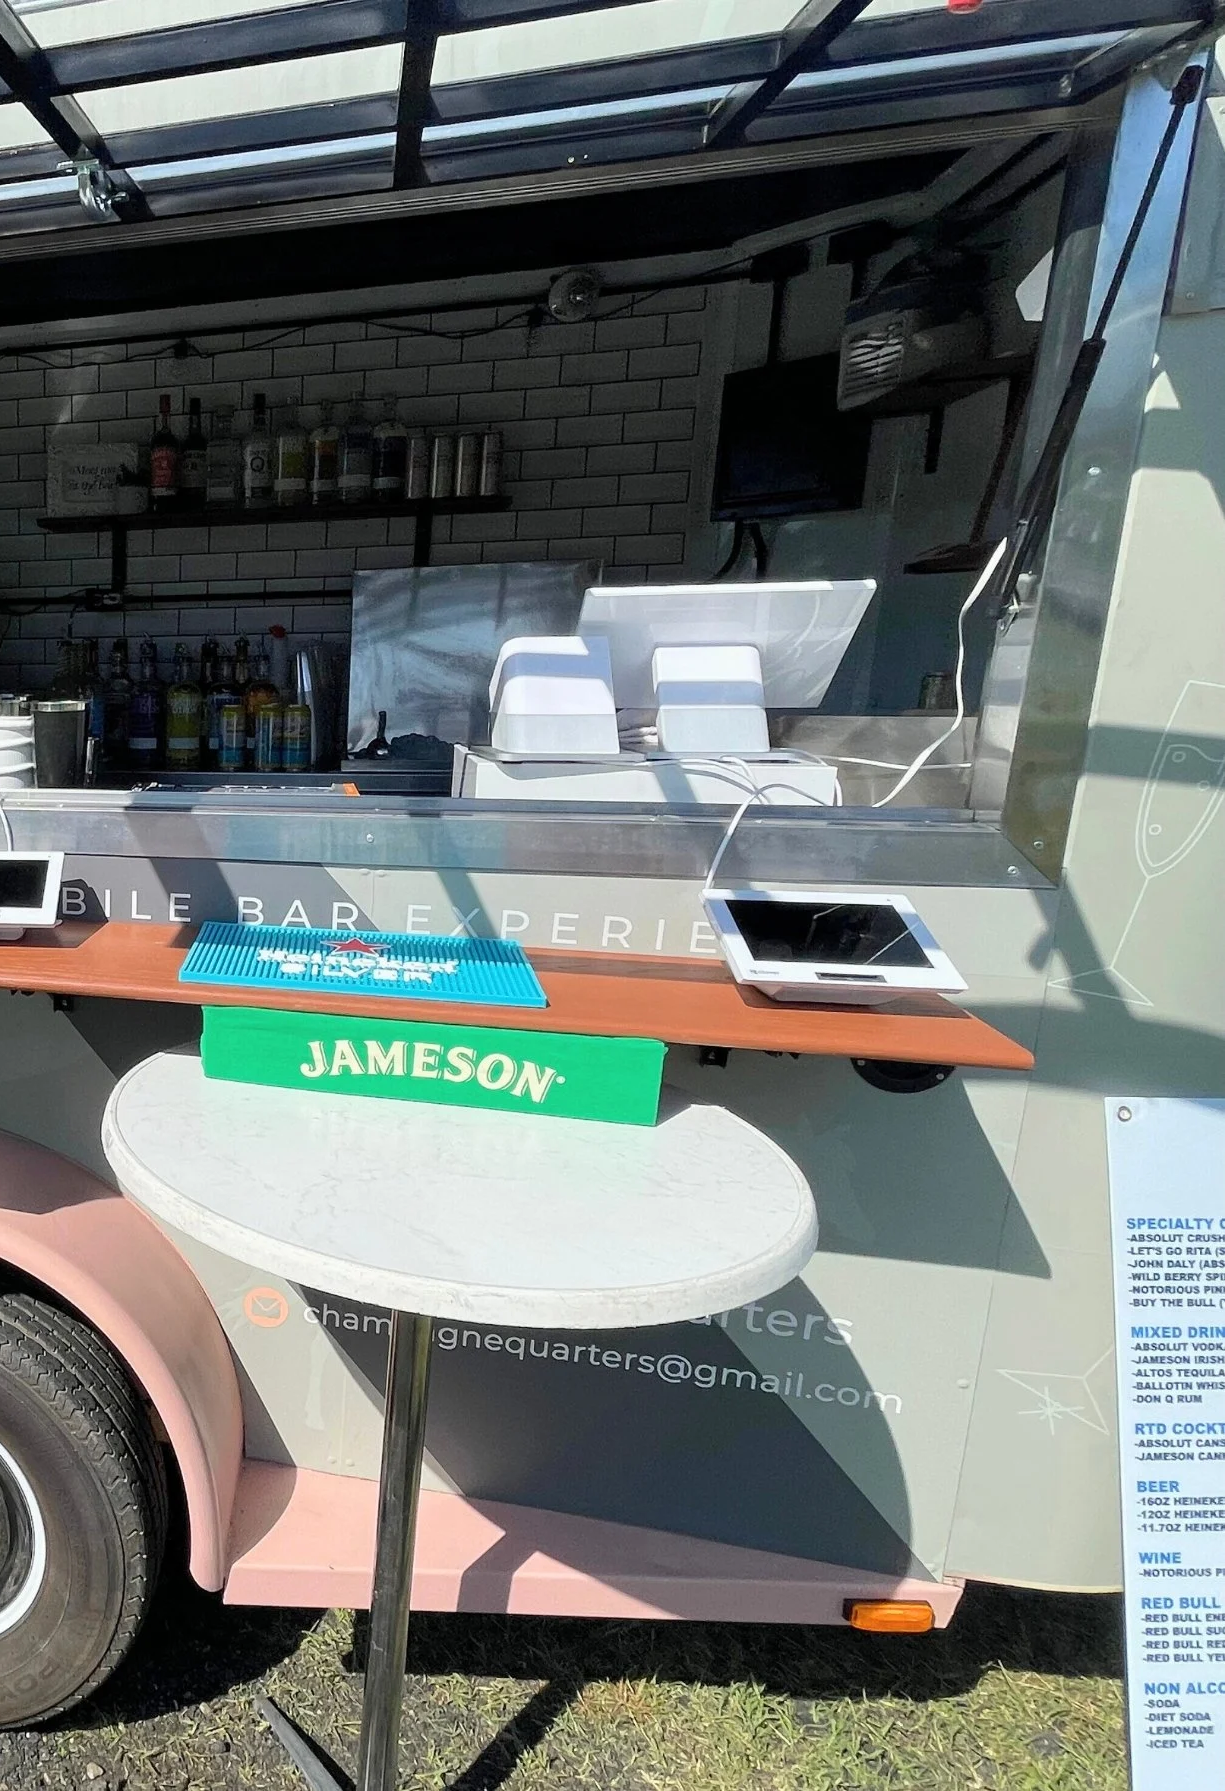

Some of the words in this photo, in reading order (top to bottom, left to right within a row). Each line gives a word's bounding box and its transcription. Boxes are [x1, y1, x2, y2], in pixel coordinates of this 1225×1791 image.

[237, 896, 362, 931] BAR
[299, 1039, 558, 1104] JAMESON
[1126, 1217, 1215, 1231] SPECIALTY
[1165, 1246, 1183, 1256] GO
[1185, 1246, 1213, 1256] RITA
[1166, 1259, 1197, 1269] DALY
[1163, 1272, 1203, 1282] BERRY
[1159, 1298, 1184, 1308] THE
[1186, 1298, 1217, 1308] BULL
[688, 1301, 854, 1346] rters
[1130, 1326, 1183, 1339] MIXED
[303, 1303, 903, 1414] chamgnequarters@gmail.com
[1164, 1394, 1174, 1405] Q
[1176, 1394, 1203, 1404] RUM
[1134, 1422, 1168, 1436] RTD
[1136, 1480, 1181, 1494] BEER
[1138, 1551, 1182, 1565] WINE
[1141, 1596, 1175, 1610] RED
[1179, 1596, 1222, 1610] BULL
[1171, 1613, 1203, 1623] BULL
[1143, 1682, 1181, 1696] NON
[1179, 1711, 1212, 1723] SODA
[1180, 1738, 1205, 1749] TEA
